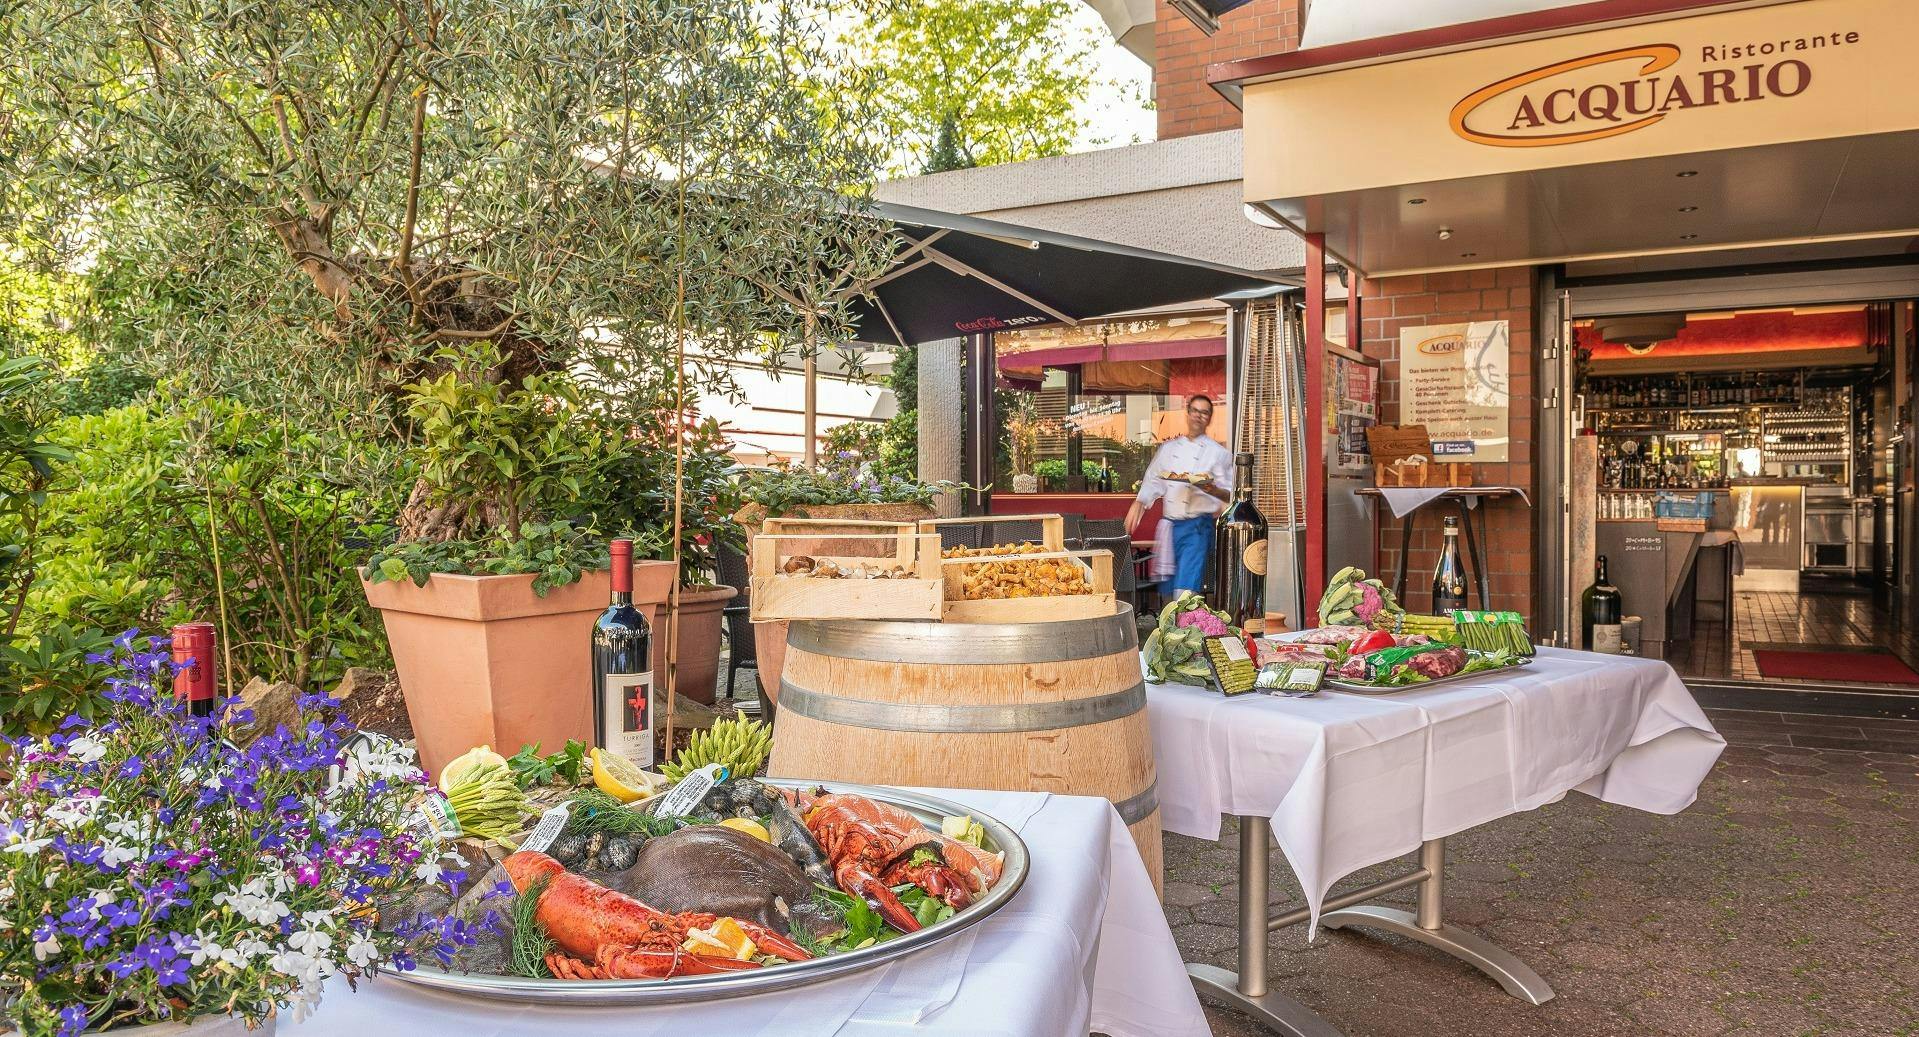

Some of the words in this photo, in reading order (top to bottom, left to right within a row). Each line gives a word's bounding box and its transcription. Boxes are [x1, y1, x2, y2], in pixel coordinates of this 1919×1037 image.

[1701, 30, 1860, 62] Ristorante
[1506, 58, 1812, 130] ACQUARIO
[1004, 316, 1039, 326] zero
[1429, 340, 1486, 352] ACQUARIO
[1070, 402, 1085, 414] NEU
